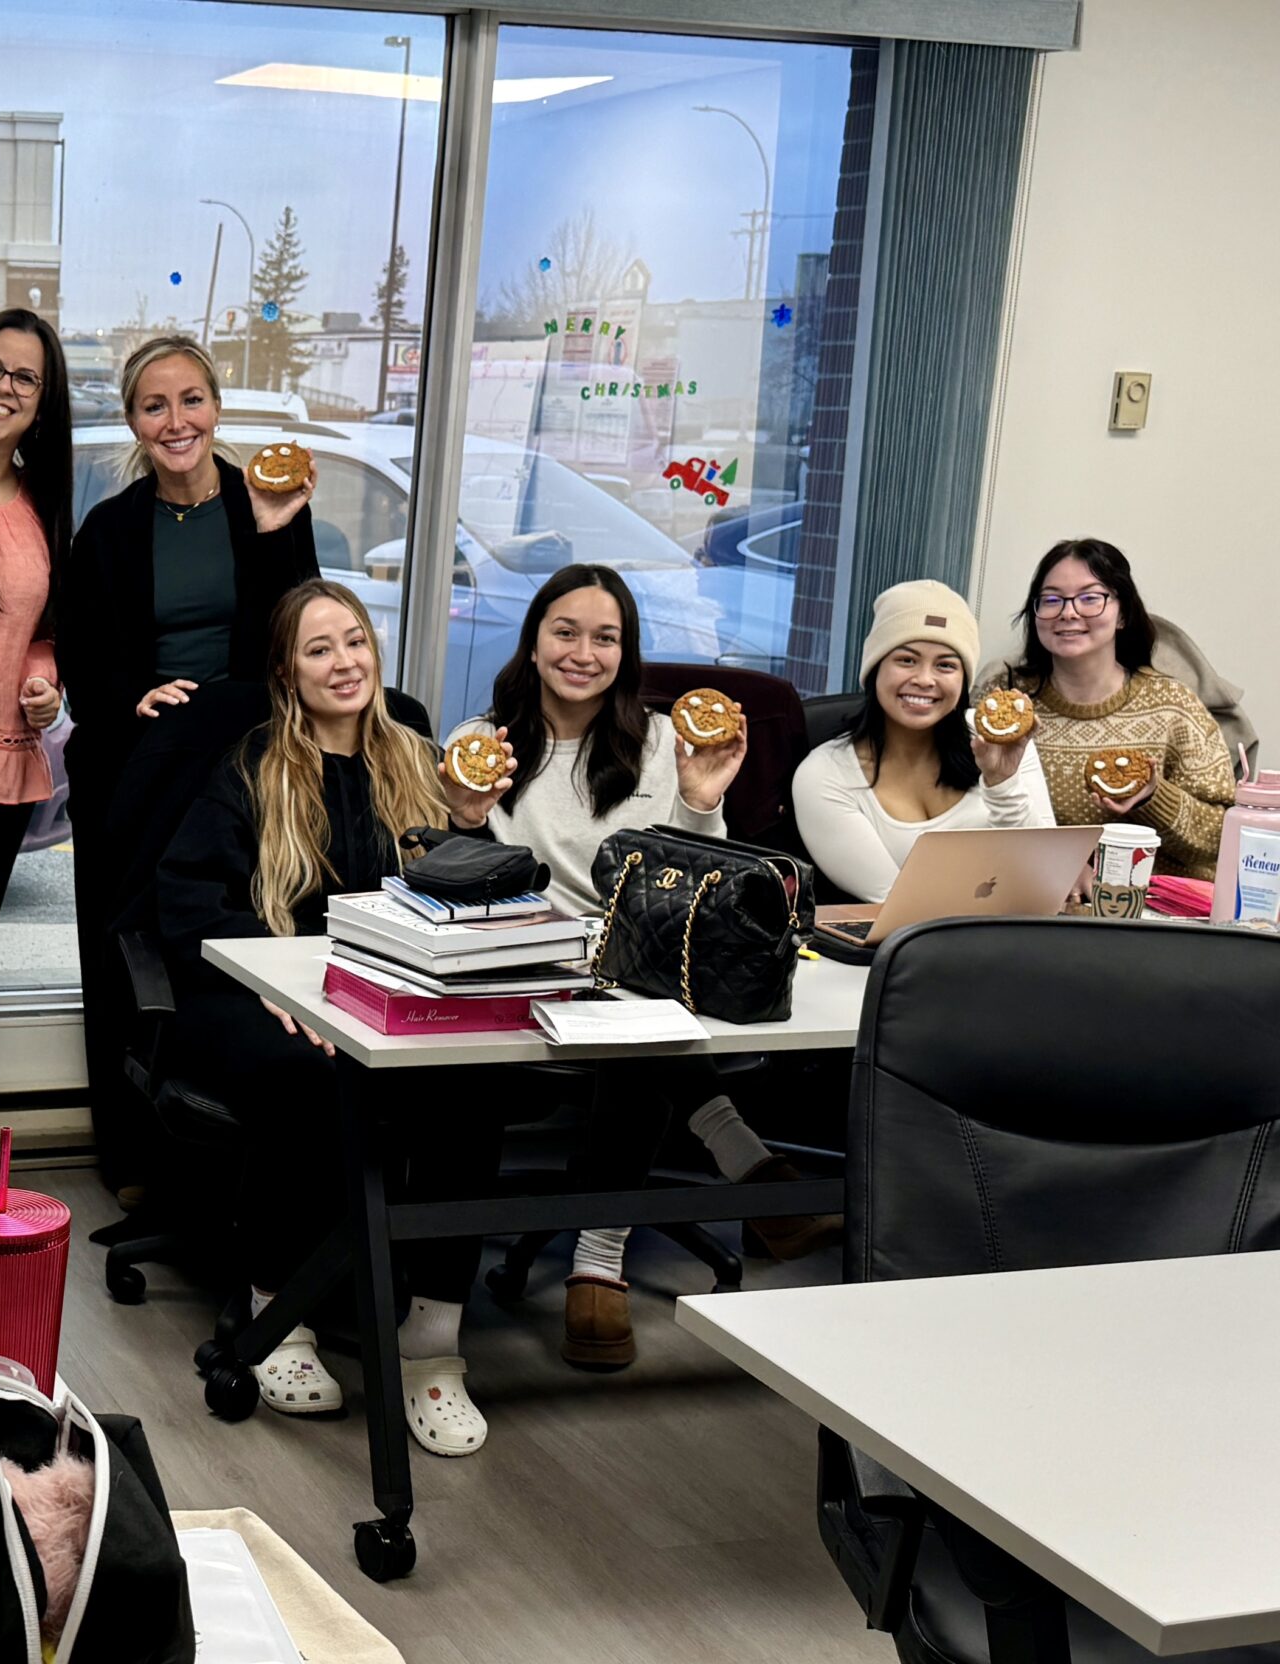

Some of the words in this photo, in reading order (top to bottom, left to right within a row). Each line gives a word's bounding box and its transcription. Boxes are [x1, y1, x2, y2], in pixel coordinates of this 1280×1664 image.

[544, 316, 626, 340] MERRY
[581, 381, 697, 401] CHRISTMAS
[401, 1010, 424, 1023] Hair
